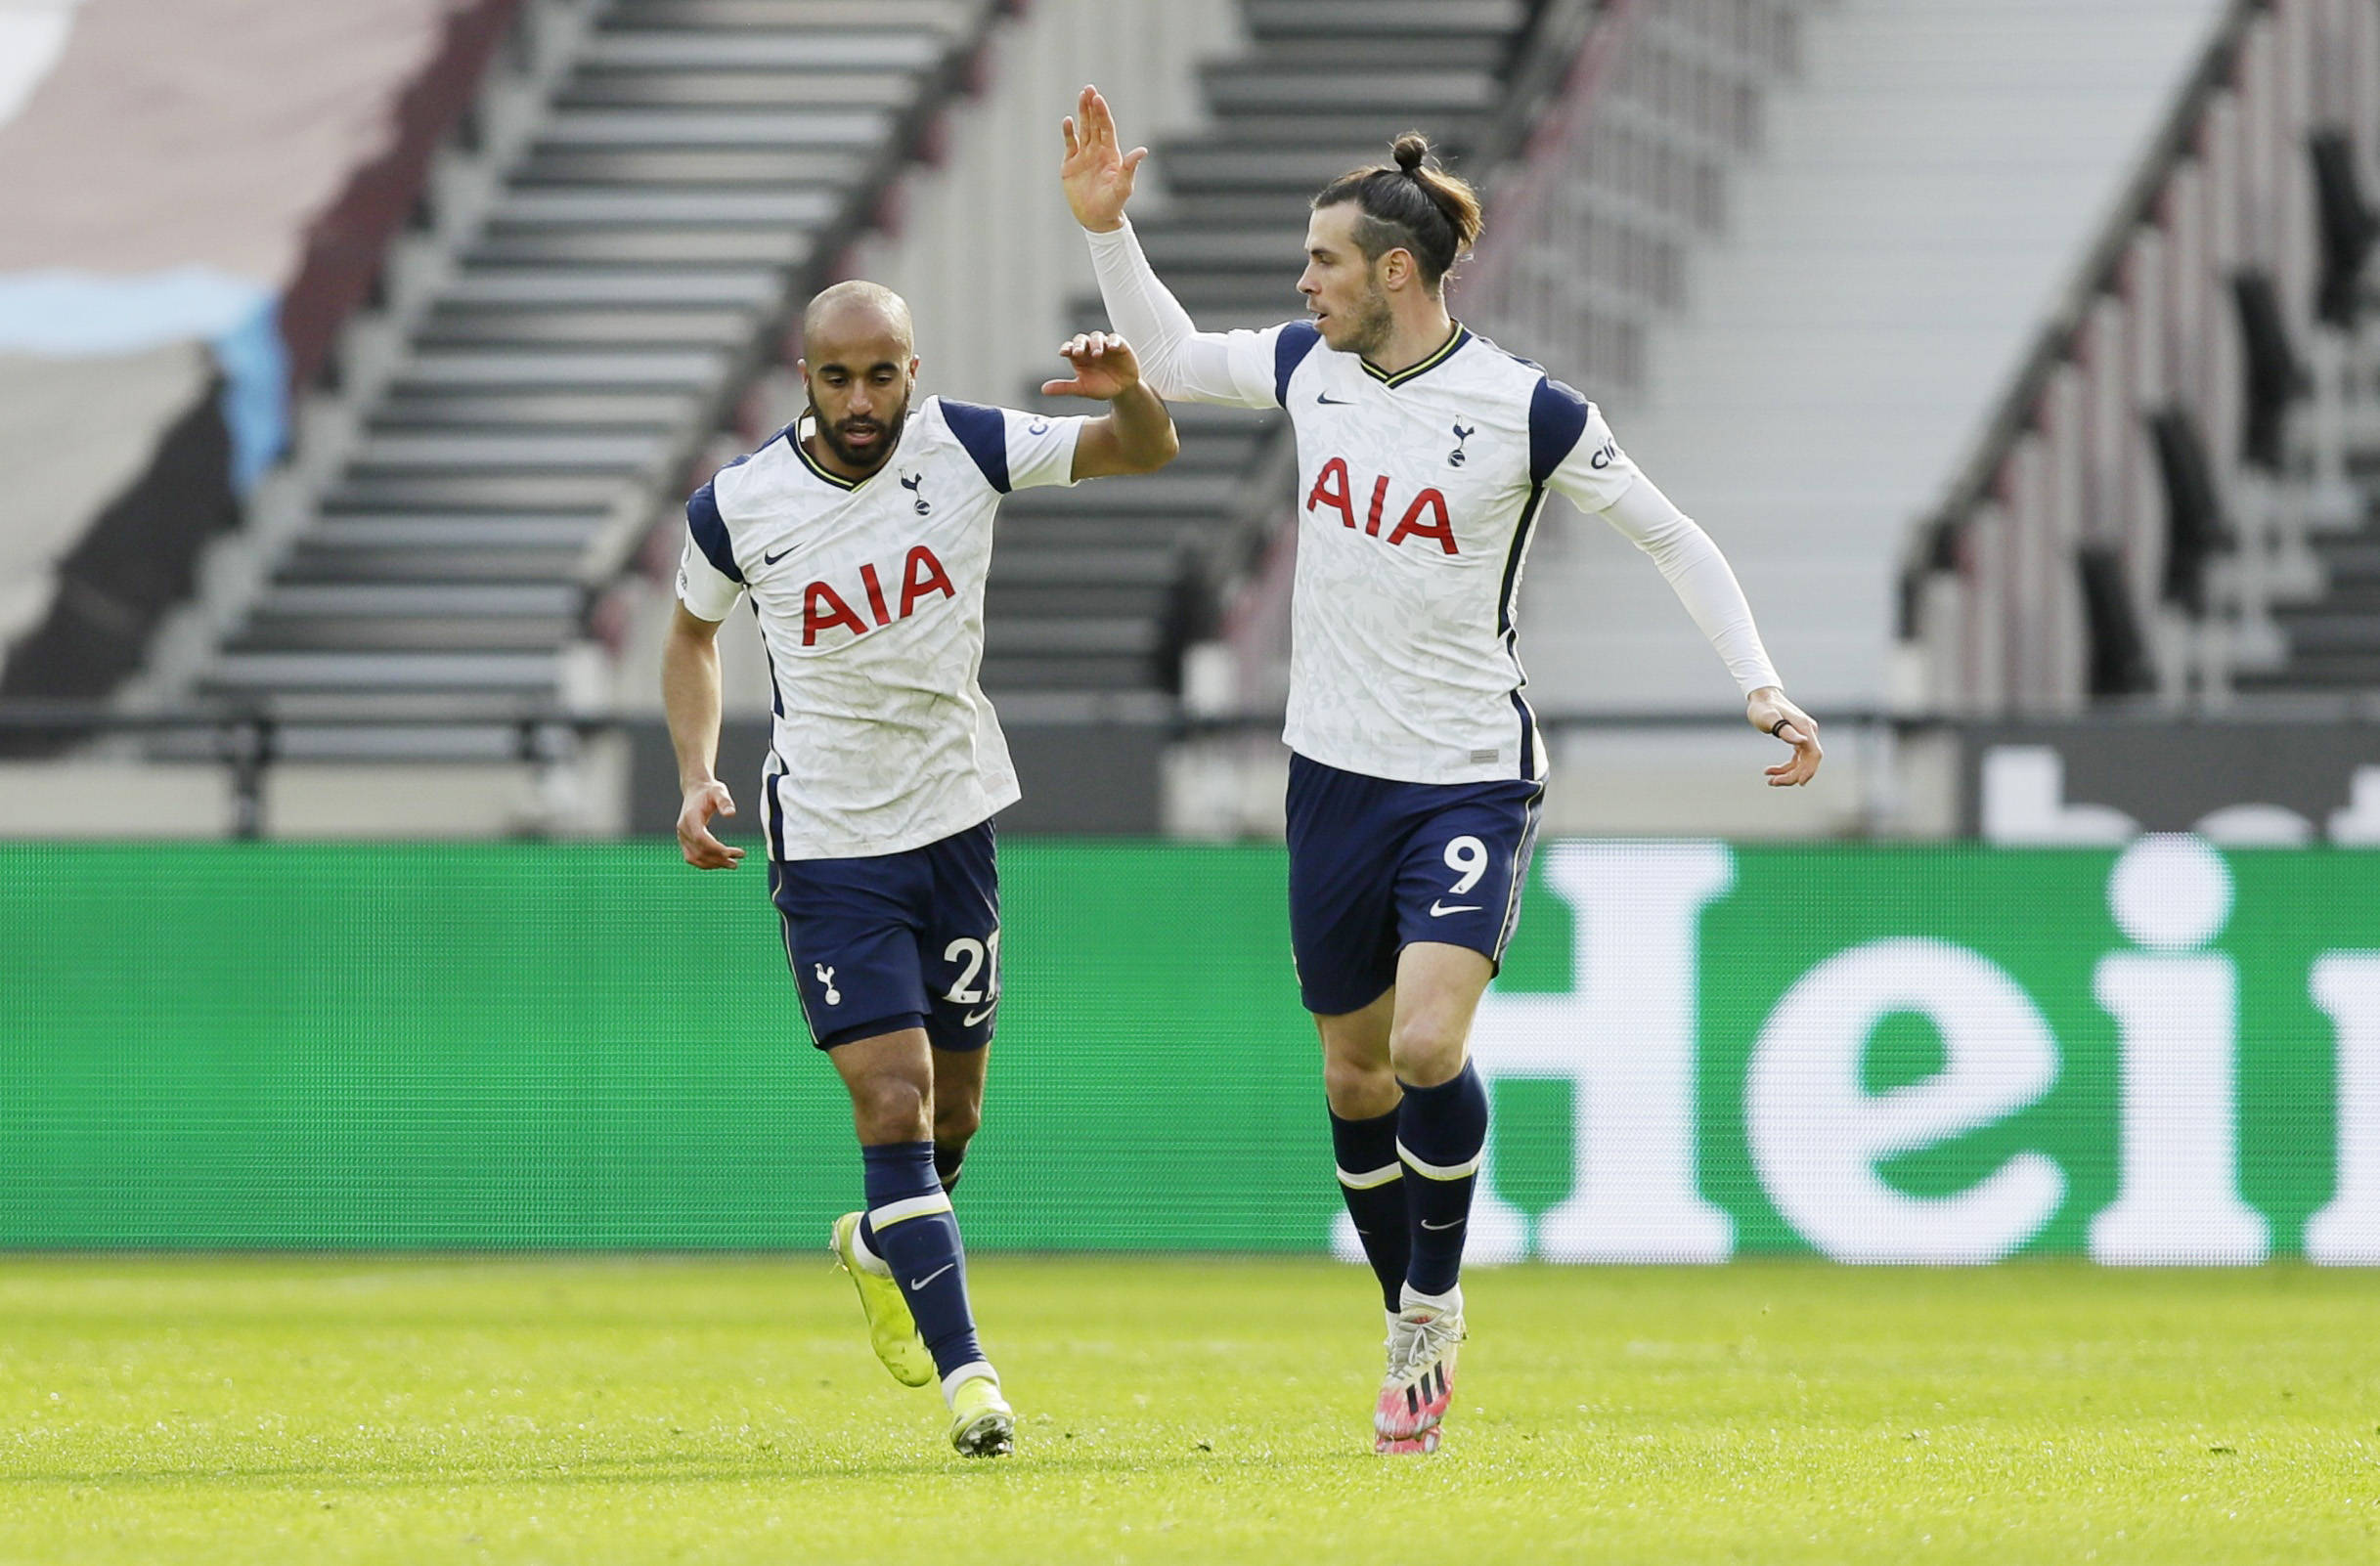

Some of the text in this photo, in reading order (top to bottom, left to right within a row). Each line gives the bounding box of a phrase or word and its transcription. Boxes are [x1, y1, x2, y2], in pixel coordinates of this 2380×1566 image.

[1306, 456, 1460, 555] AIA
[801, 544, 955, 647] AIA
[1443, 835, 1488, 894] 9
[942, 927, 999, 1004] 21
